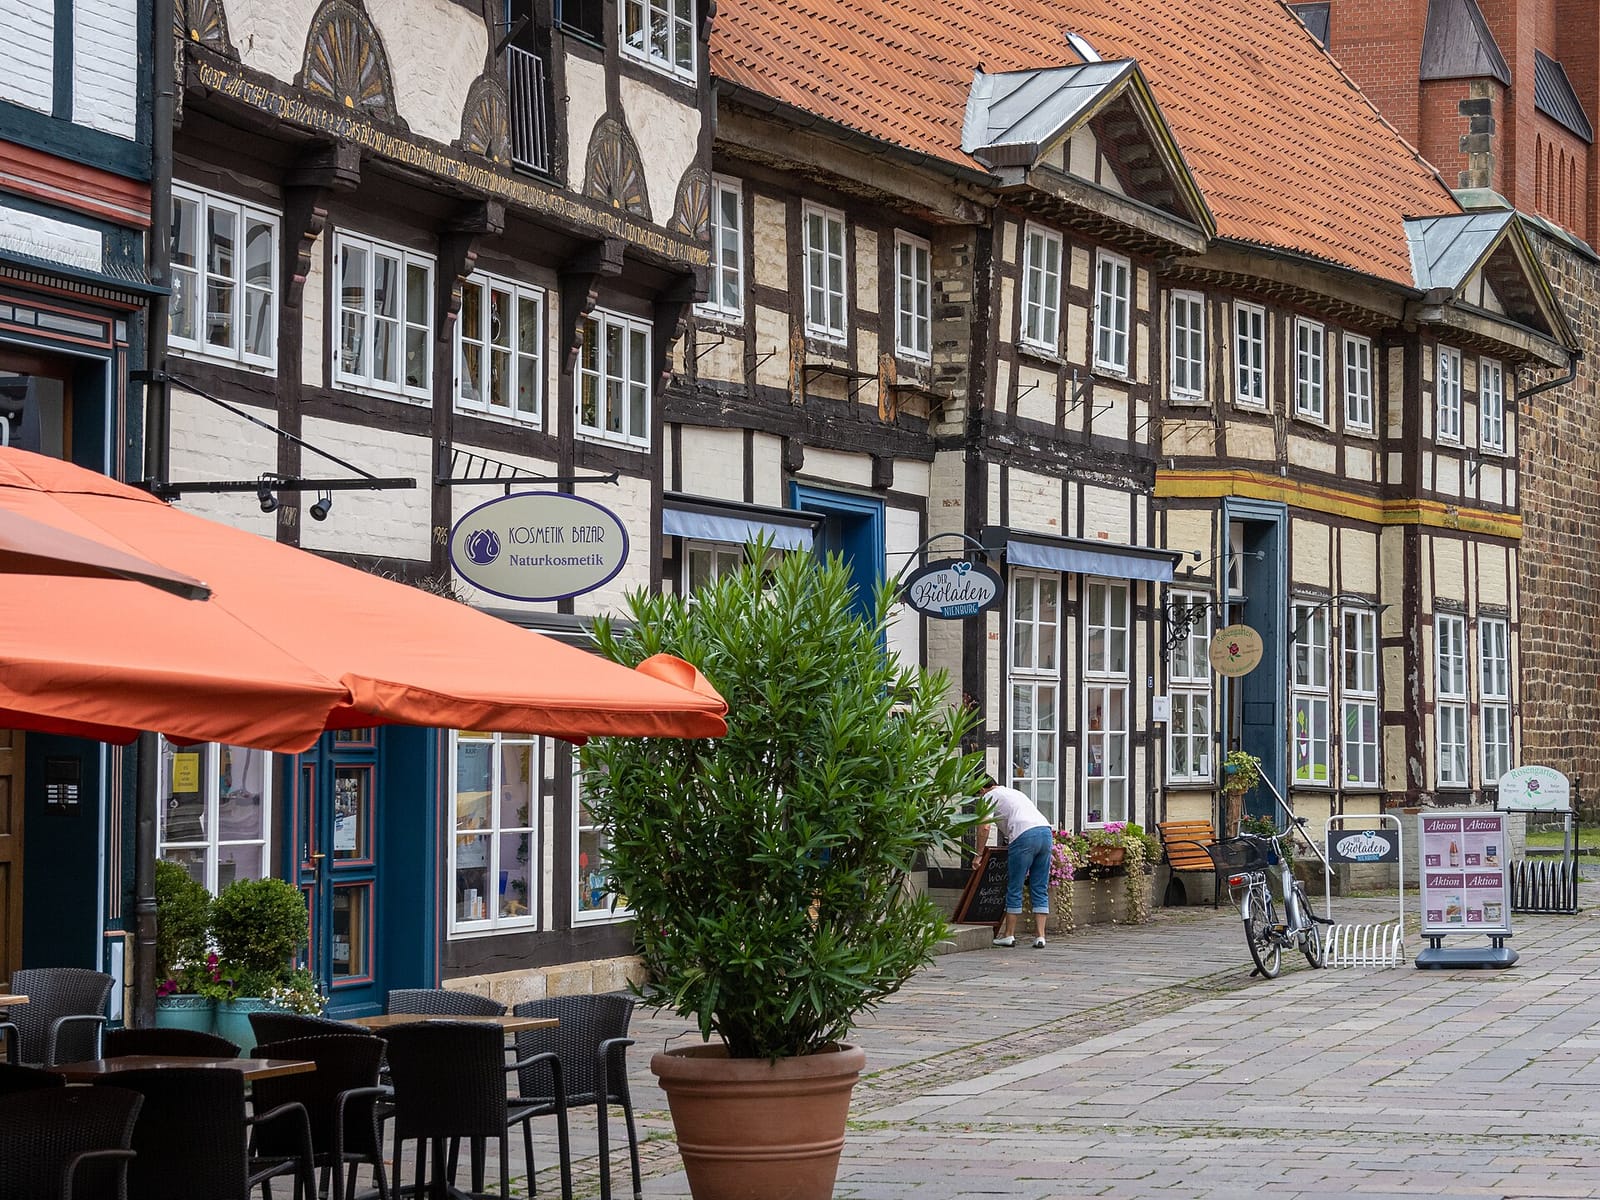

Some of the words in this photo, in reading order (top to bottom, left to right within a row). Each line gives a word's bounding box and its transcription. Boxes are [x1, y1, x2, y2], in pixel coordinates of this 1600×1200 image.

[508, 526, 564, 545] KOSMETIK
[572, 525, 605, 544] BAZAR
[509, 553, 604, 567] Naturkosmetik
[936, 573, 947, 585] DER
[915, 579, 991, 609] Bioladen
[943, 603, 978, 617] NIENBURG
[1510, 766, 1559, 781] Rosengarten
[1427, 820, 1457, 831] Aktion
[1466, 819, 1497, 830] Aktion
[1340, 840, 1387, 857] Bioladen
[1430, 875, 1460, 886] Aktion
[1469, 875, 1498, 886] Aktion
